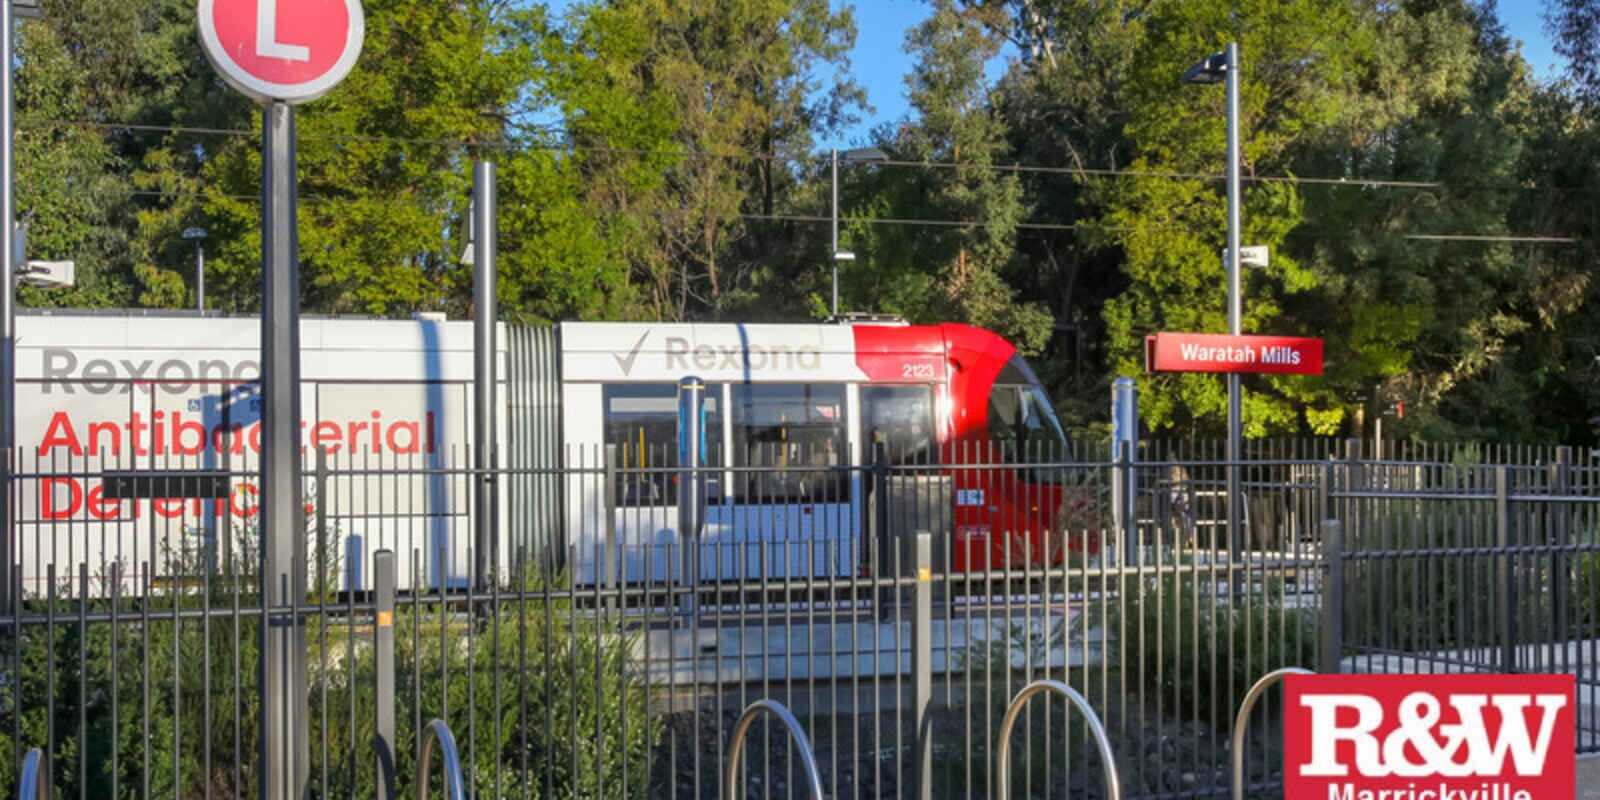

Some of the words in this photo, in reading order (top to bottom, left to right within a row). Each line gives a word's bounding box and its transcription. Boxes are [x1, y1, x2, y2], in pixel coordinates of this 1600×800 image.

[256, 0, 310, 62] L
[664, 336, 822, 371] Rexona
[903, 363, 936, 378] 2123
[1180, 343, 1256, 363] Waratah
[1261, 345, 1301, 365] Mills
[38, 410, 436, 457] Antibaerial
